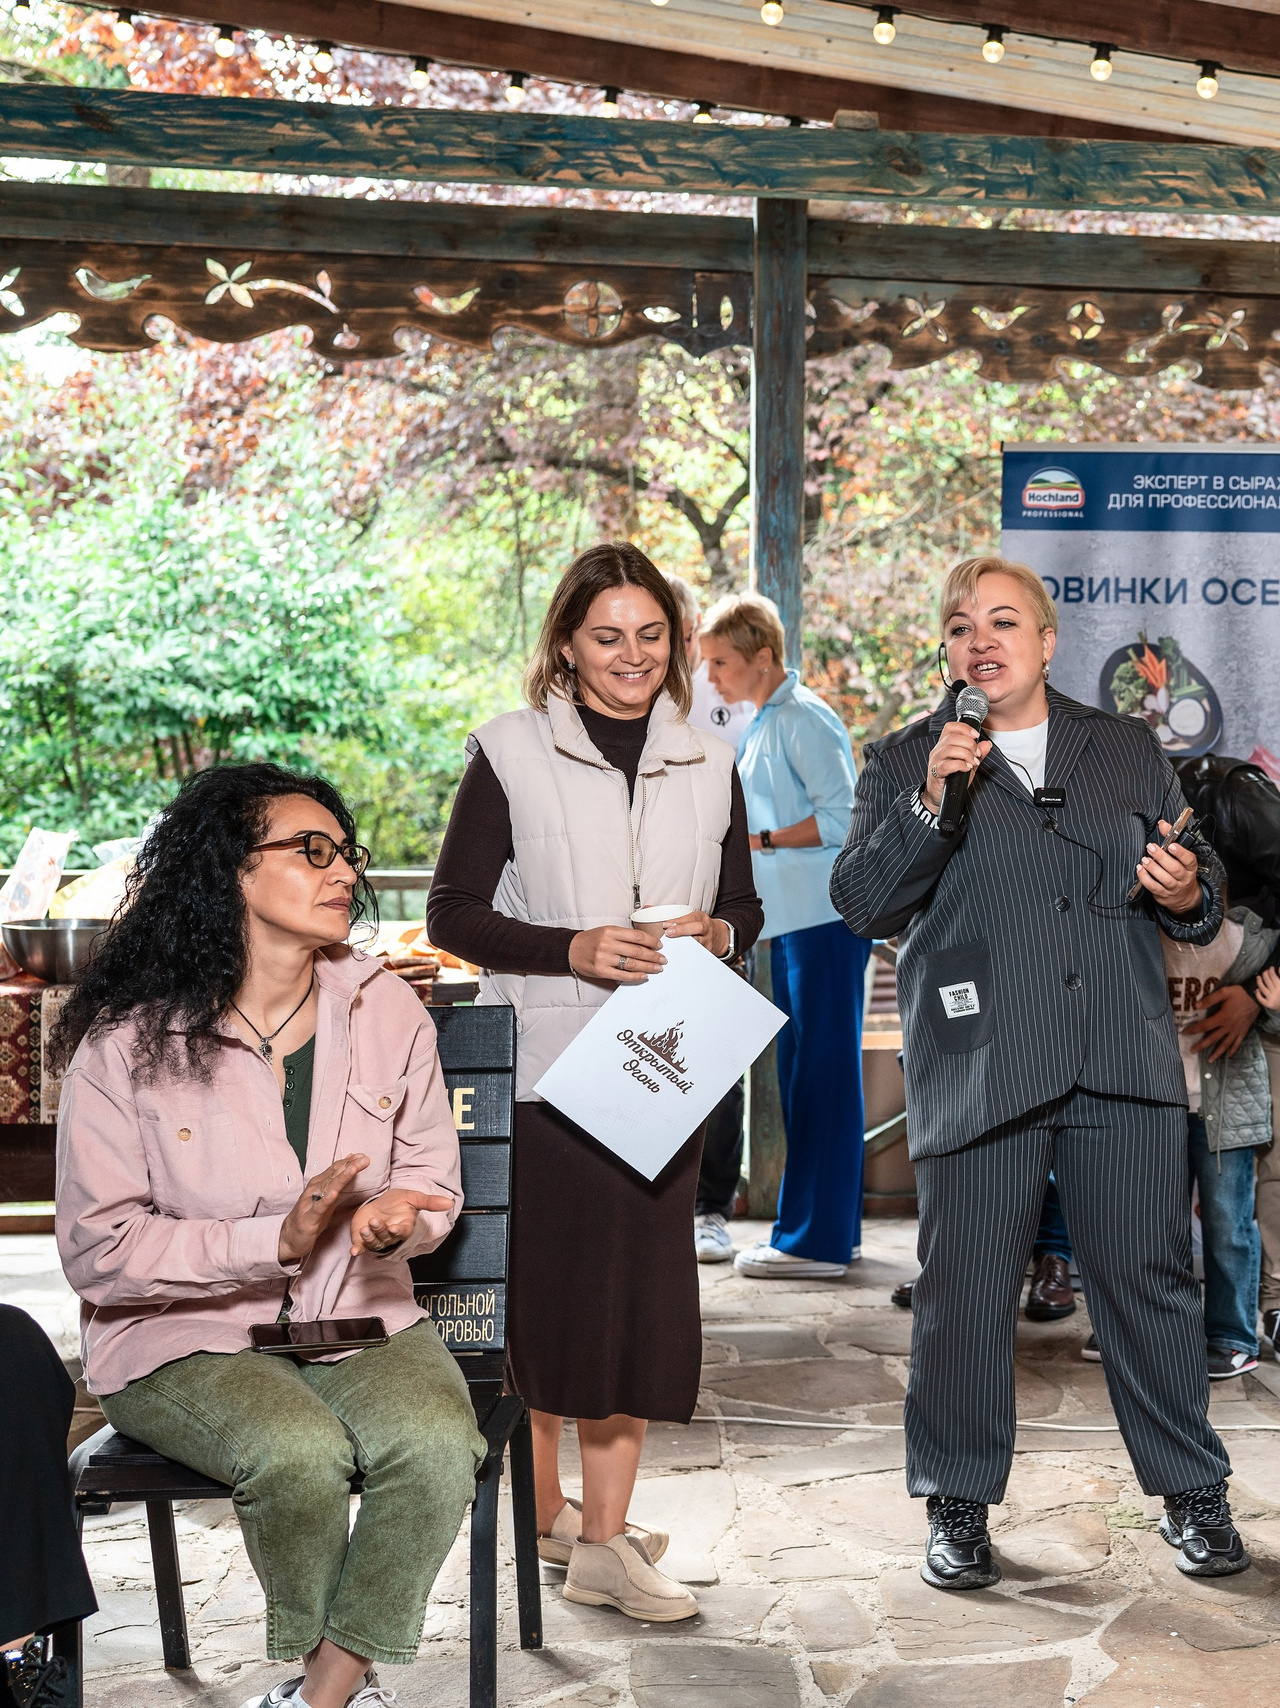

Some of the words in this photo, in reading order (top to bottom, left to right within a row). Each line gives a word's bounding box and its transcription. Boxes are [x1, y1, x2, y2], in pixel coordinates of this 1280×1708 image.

[1133, 475, 1208, 490] ЭКСПЕРТ
[1213, 475, 1225, 490] В
[1028, 493, 1079, 502] Hochland
[1107, 493, 1144, 511] ДЛЯ
[1022, 510, 1084, 518] PROFESSIONAL
[1041, 576, 1188, 604] ОВИНКИ
[616, 1029, 695, 1095] Открытый
[622, 1059, 660, 1094] Огонь
[416, 1288, 496, 1317] ОГОЛЬНОЙ
[436, 1318, 495, 1343] ОРОВЬЮ
